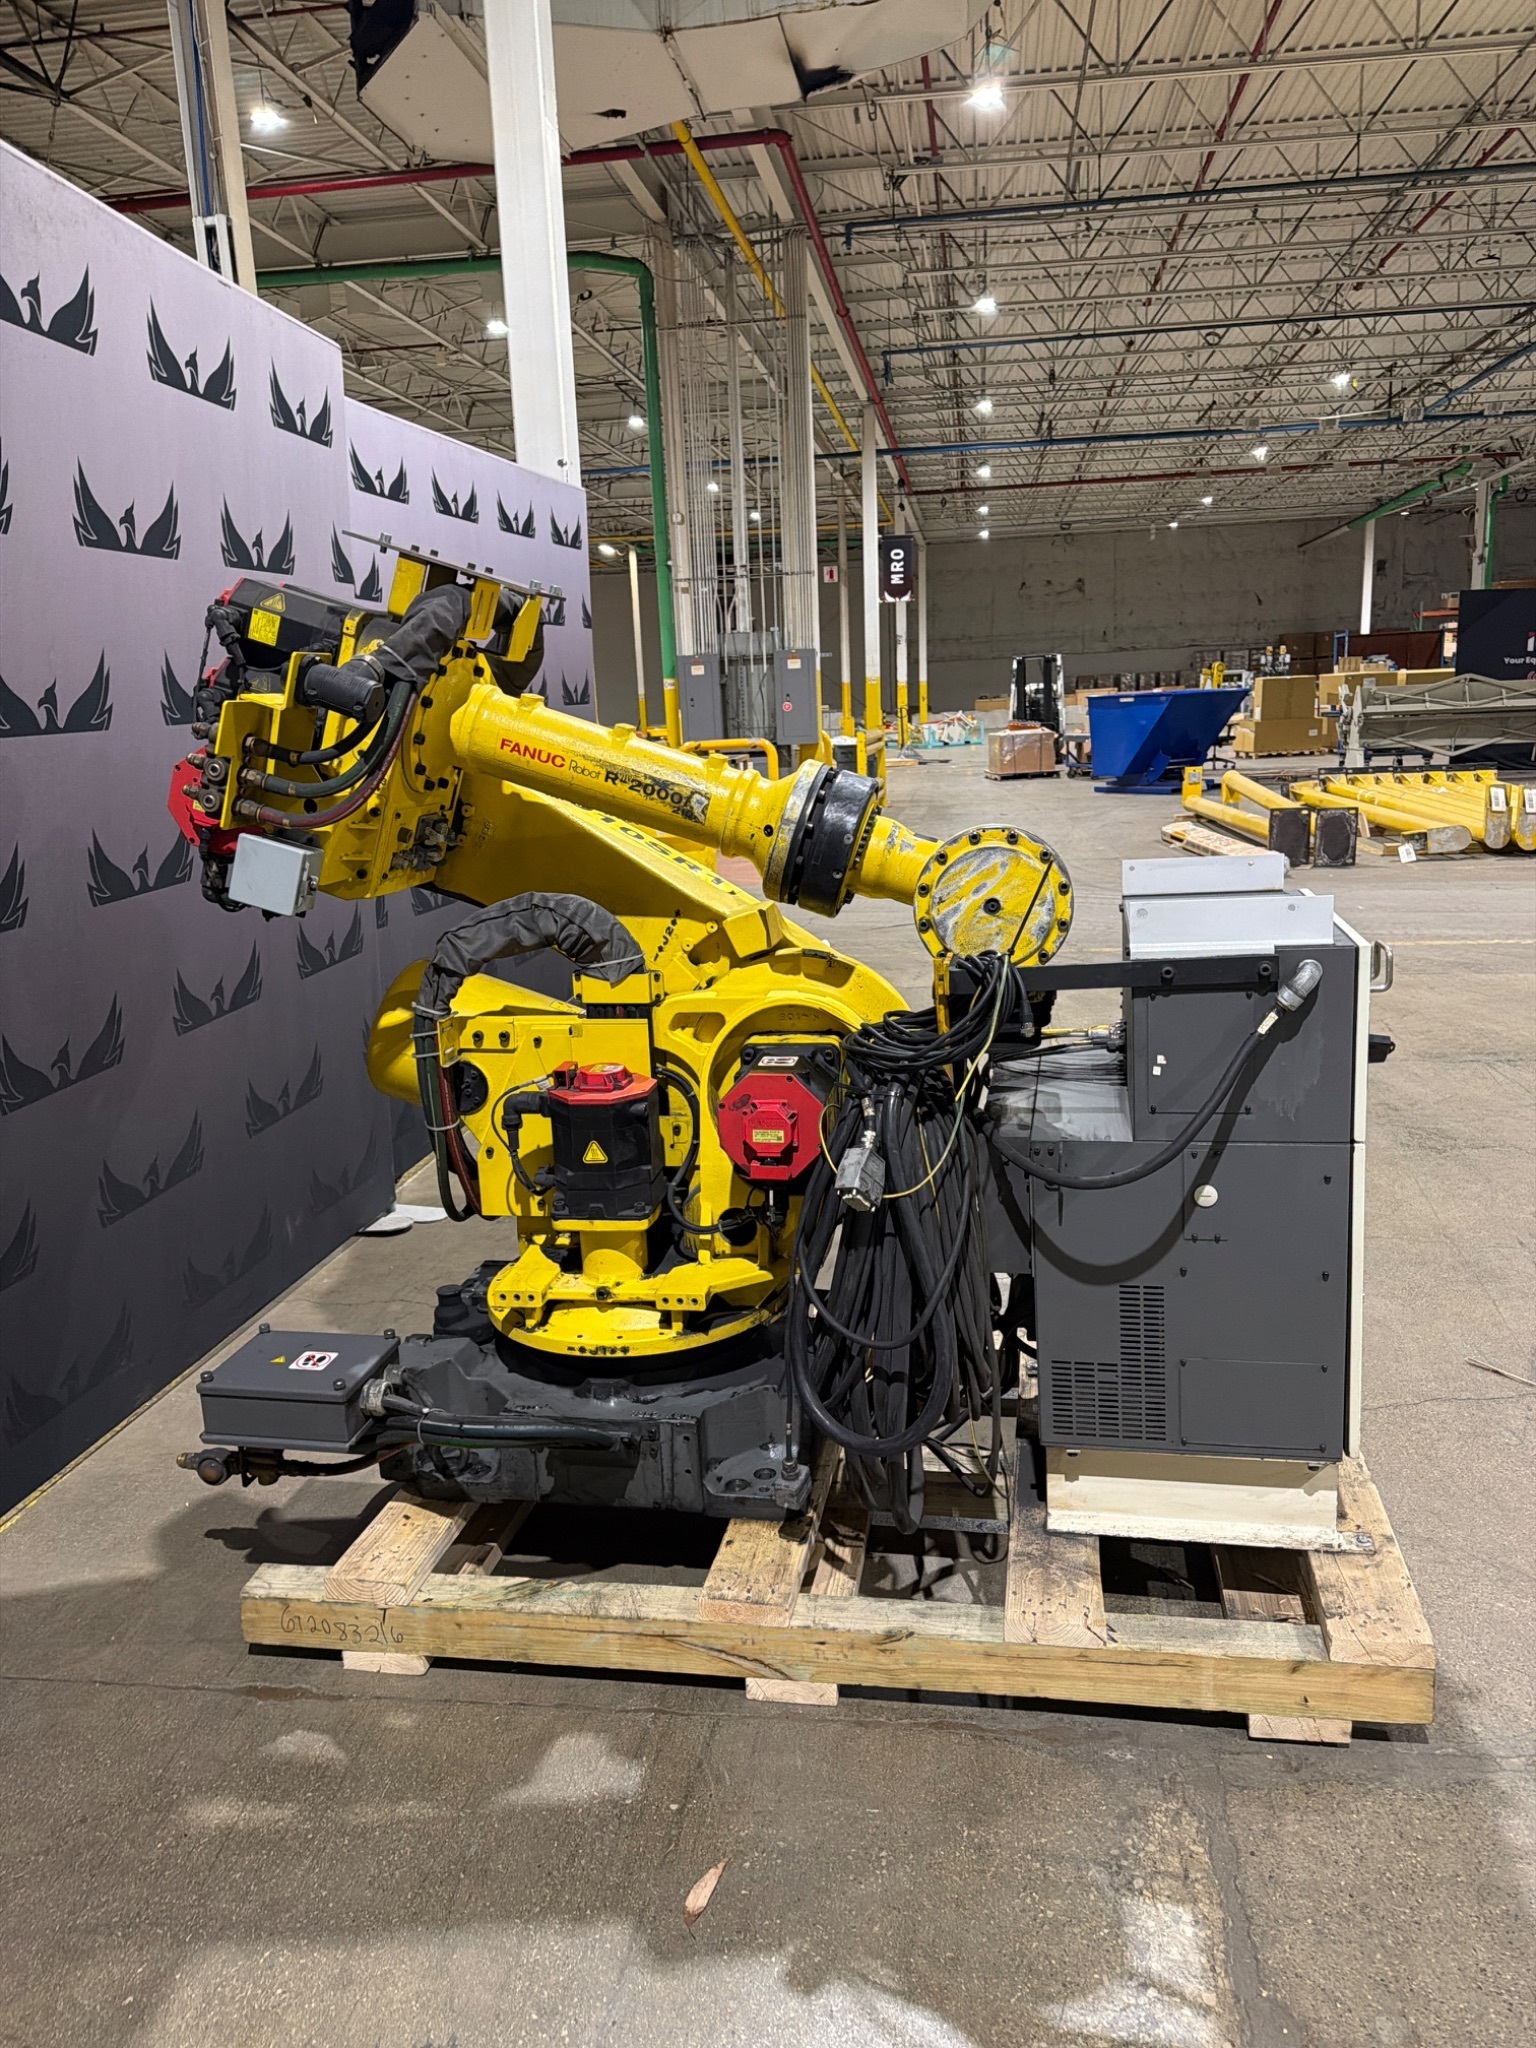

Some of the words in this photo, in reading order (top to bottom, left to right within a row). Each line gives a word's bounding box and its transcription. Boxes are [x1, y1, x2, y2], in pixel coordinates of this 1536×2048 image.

[890, 548, 905, 584] MRO
[1503, 656, 1525, 664] Your
[1525, 656, 1536, 666] Eq
[500, 738, 566, 768] FANUC
[568, 759, 602, 780] Robot
